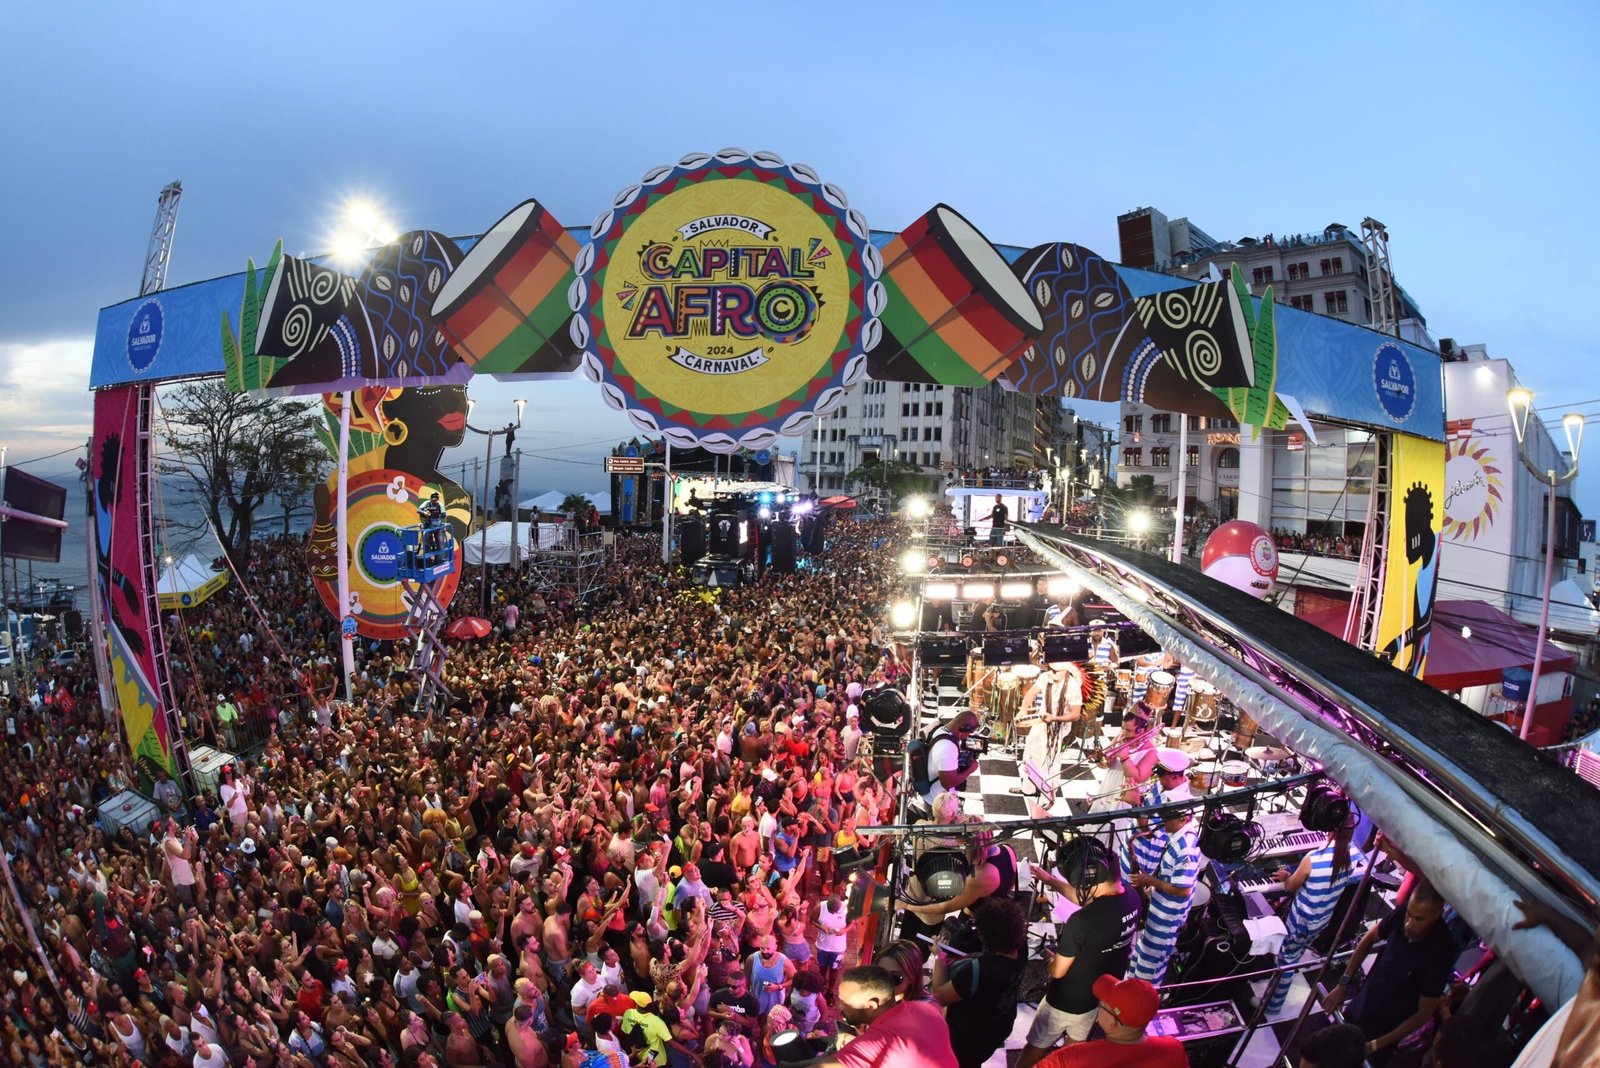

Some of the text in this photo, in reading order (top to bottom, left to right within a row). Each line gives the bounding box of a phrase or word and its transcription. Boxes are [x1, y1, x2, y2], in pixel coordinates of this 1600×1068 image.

[689, 216, 760, 233] SALVADOR
[643, 244, 815, 279] CAPITAL
[629, 283, 816, 343] AFRO
[131, 334, 156, 346] SALVADOR
[706, 346, 734, 355] 2024
[684, 354, 759, 373] CARNAVAL
[1380, 378, 1410, 395] SALVADOR
